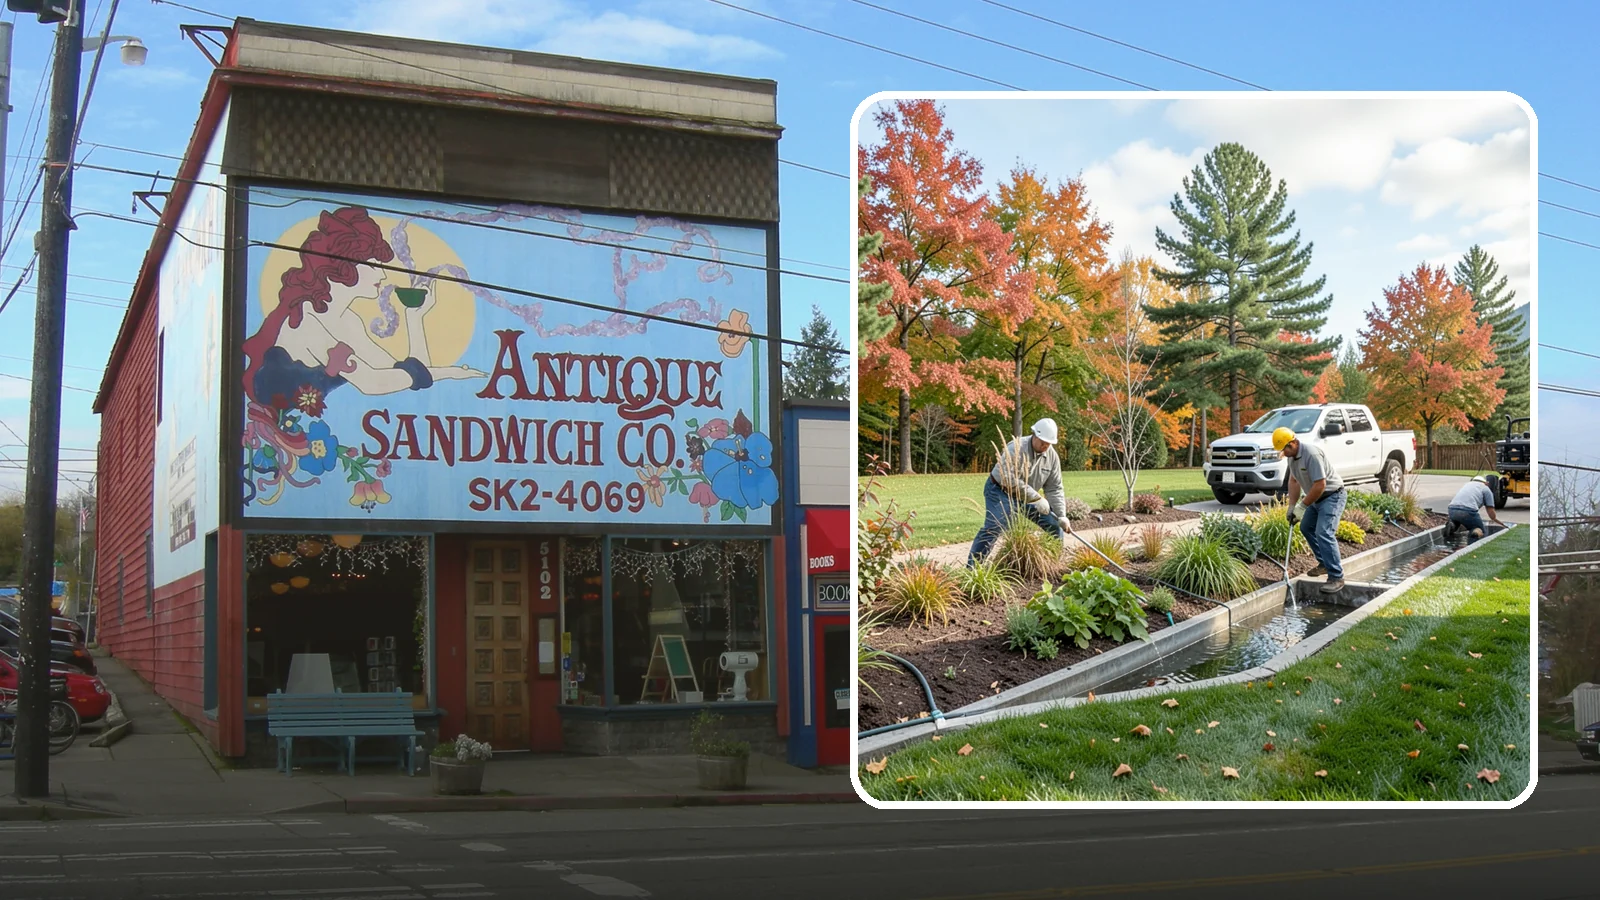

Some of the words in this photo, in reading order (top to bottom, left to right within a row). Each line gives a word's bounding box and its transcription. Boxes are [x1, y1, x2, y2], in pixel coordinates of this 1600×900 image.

[475, 328, 723, 421] ANTIQUE
[361, 408, 604, 467] SANDWICH
[617, 422, 685, 469] CO.
[468, 477, 646, 513] SK2-4069
[540, 541, 551, 600] 5102
[809, 555, 835, 569] BOOKS
